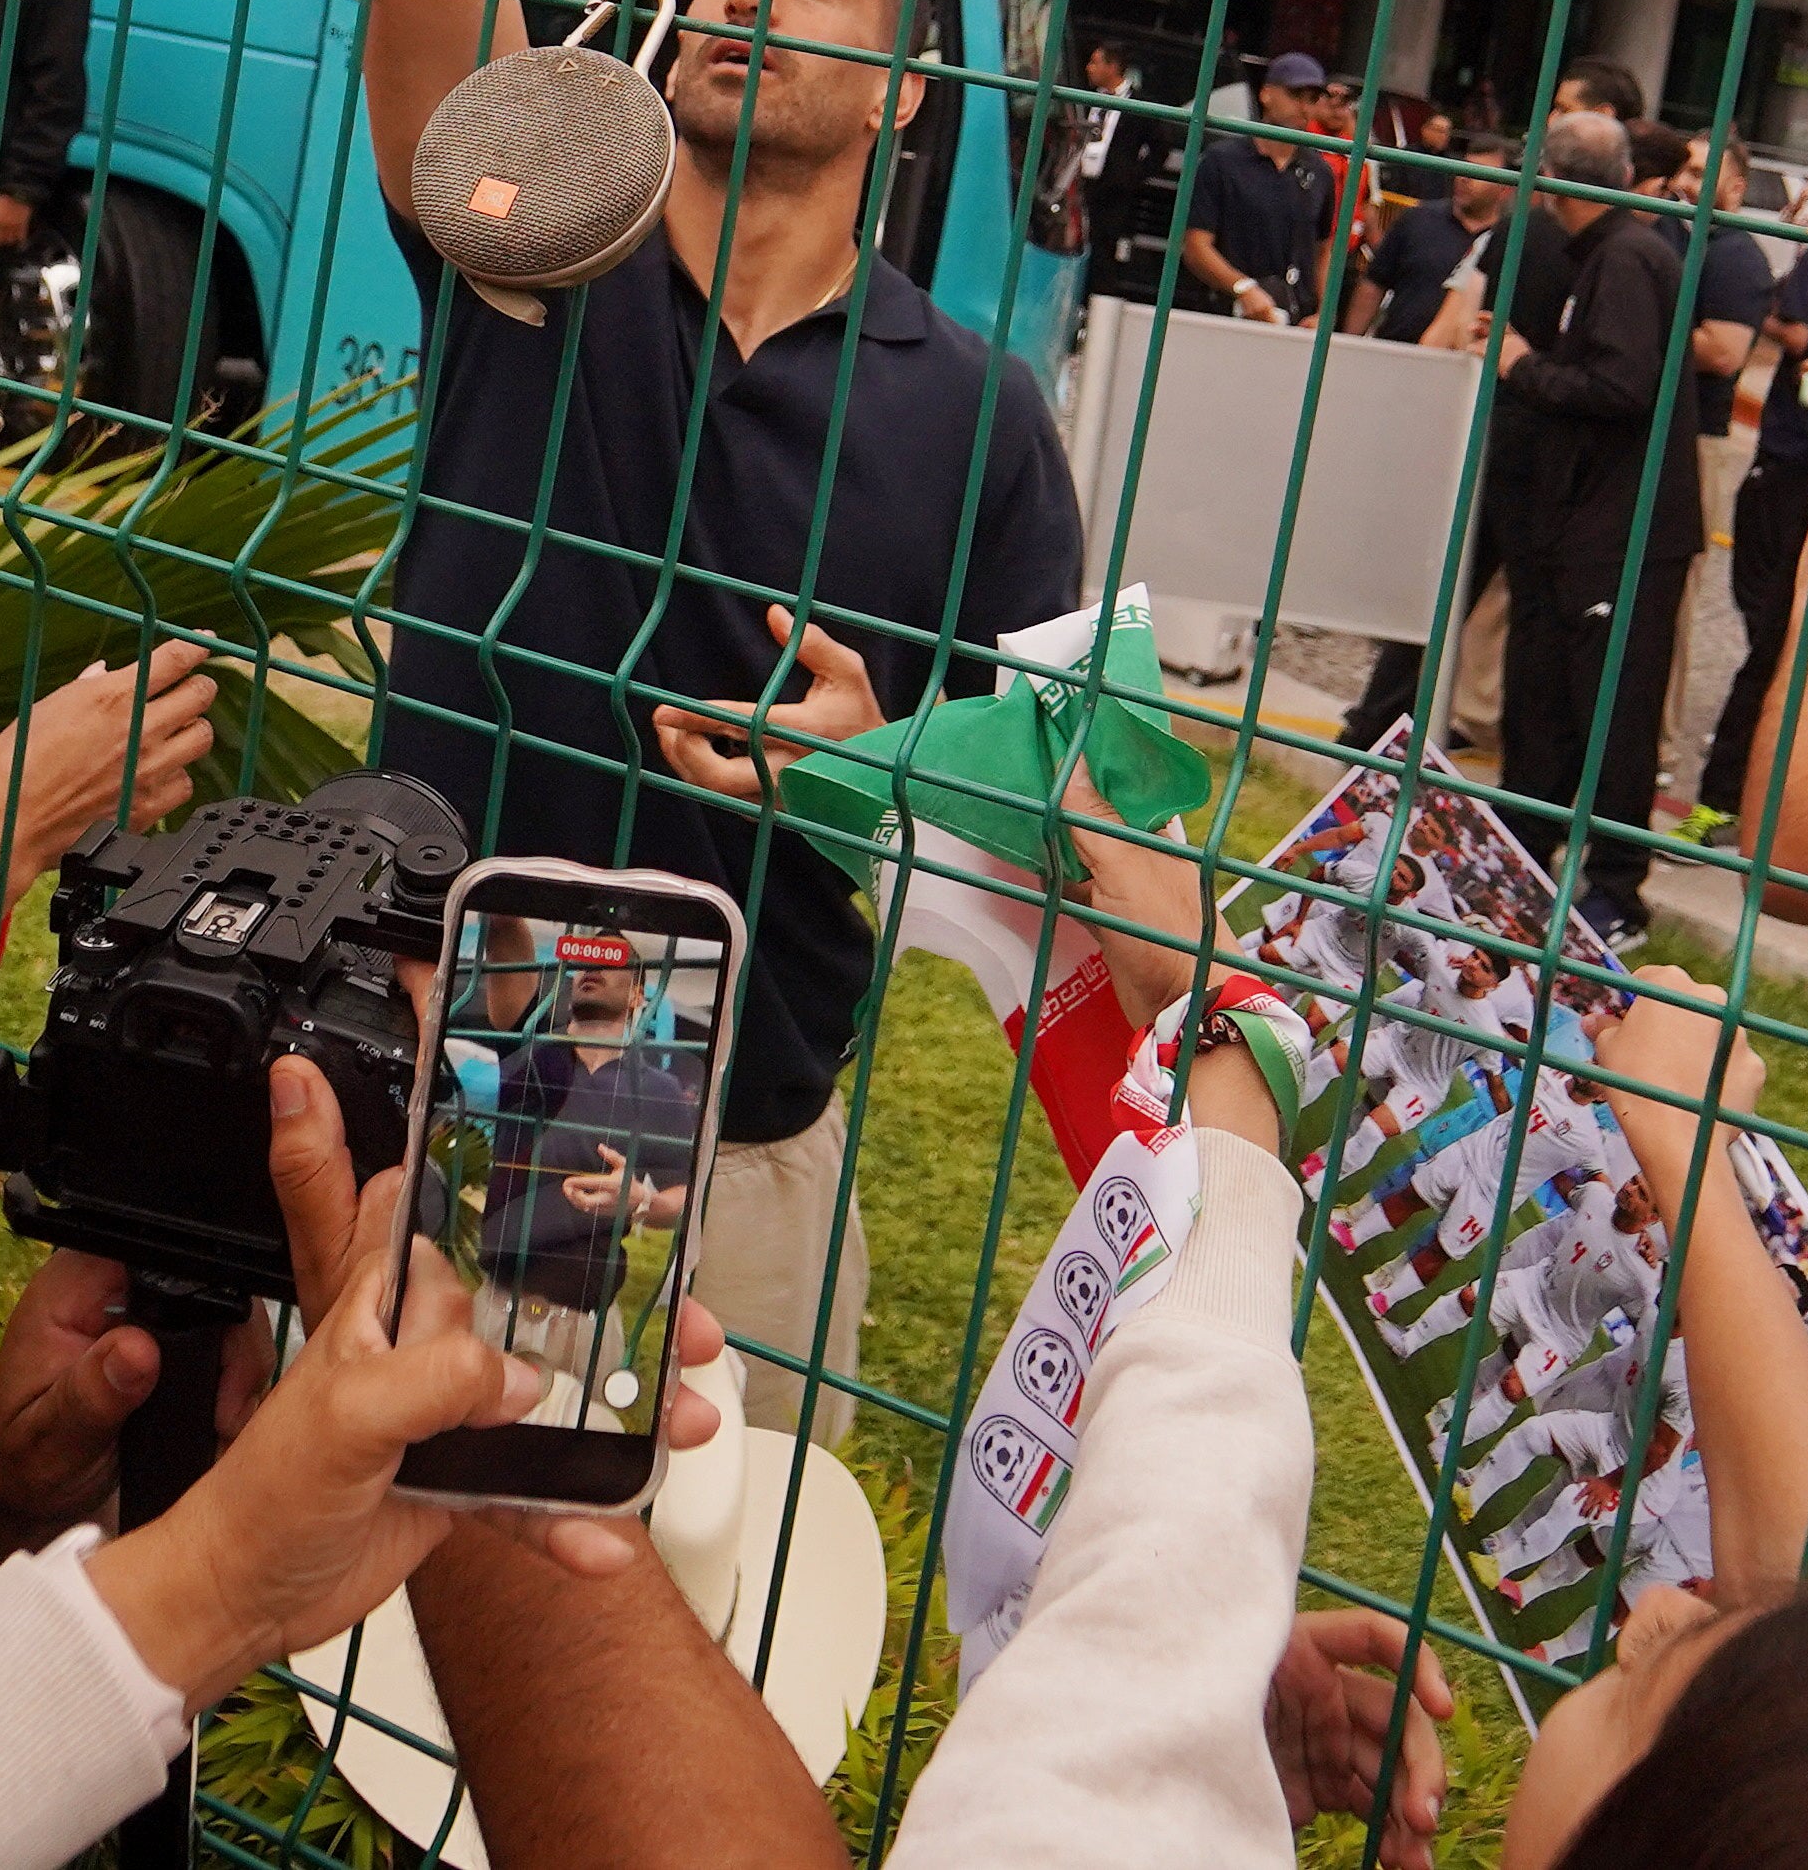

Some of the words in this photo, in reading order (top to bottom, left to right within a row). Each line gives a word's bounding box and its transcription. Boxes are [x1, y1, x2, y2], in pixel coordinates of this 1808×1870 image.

[561, 941, 623, 962] 00:00:00
[59, 1012, 79, 1025] MENU
[356, 1041, 383, 1060] AF-ON
